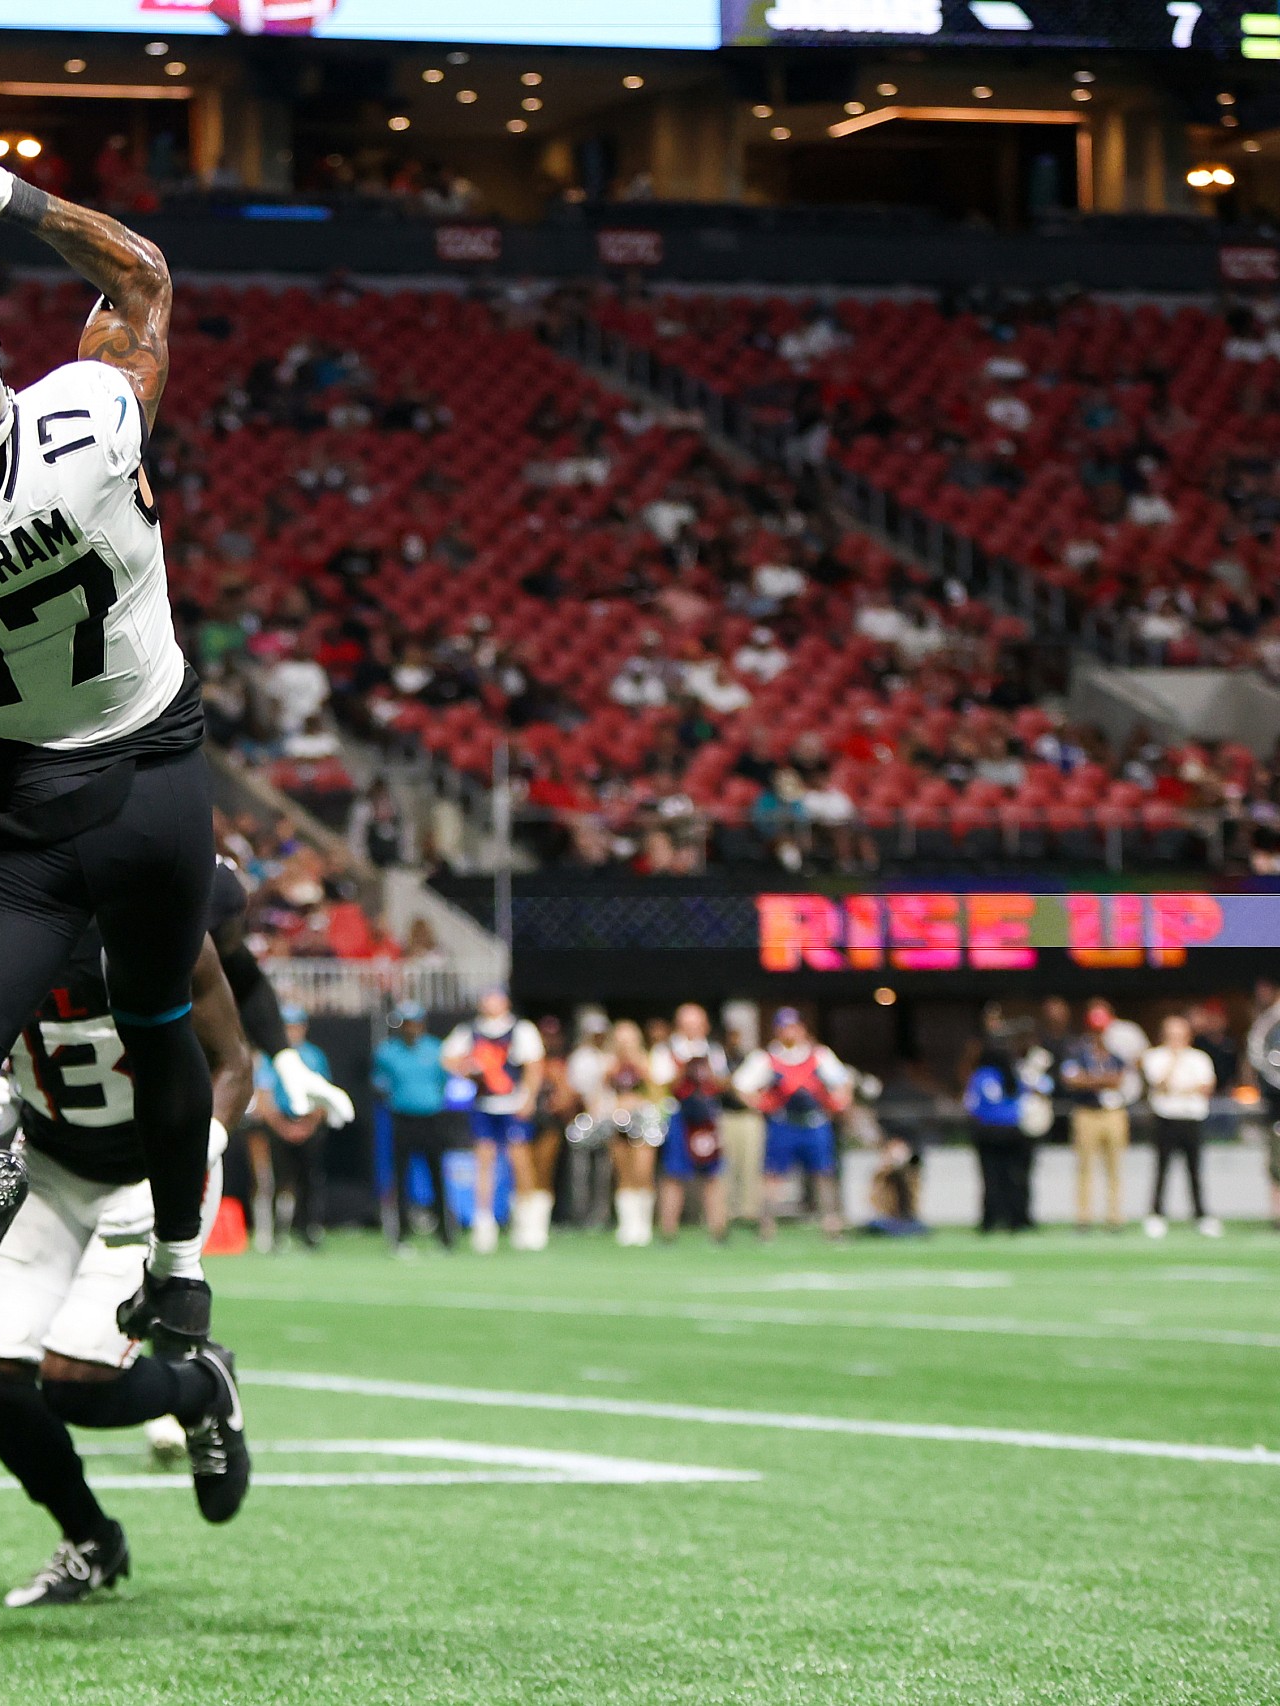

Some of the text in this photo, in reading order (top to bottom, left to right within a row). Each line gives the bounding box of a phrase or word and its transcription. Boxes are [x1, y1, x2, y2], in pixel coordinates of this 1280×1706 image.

[1166, 1, 1202, 49] 7
[36, 410, 98, 464] 17
[758, 893, 1224, 971] RISE UP
